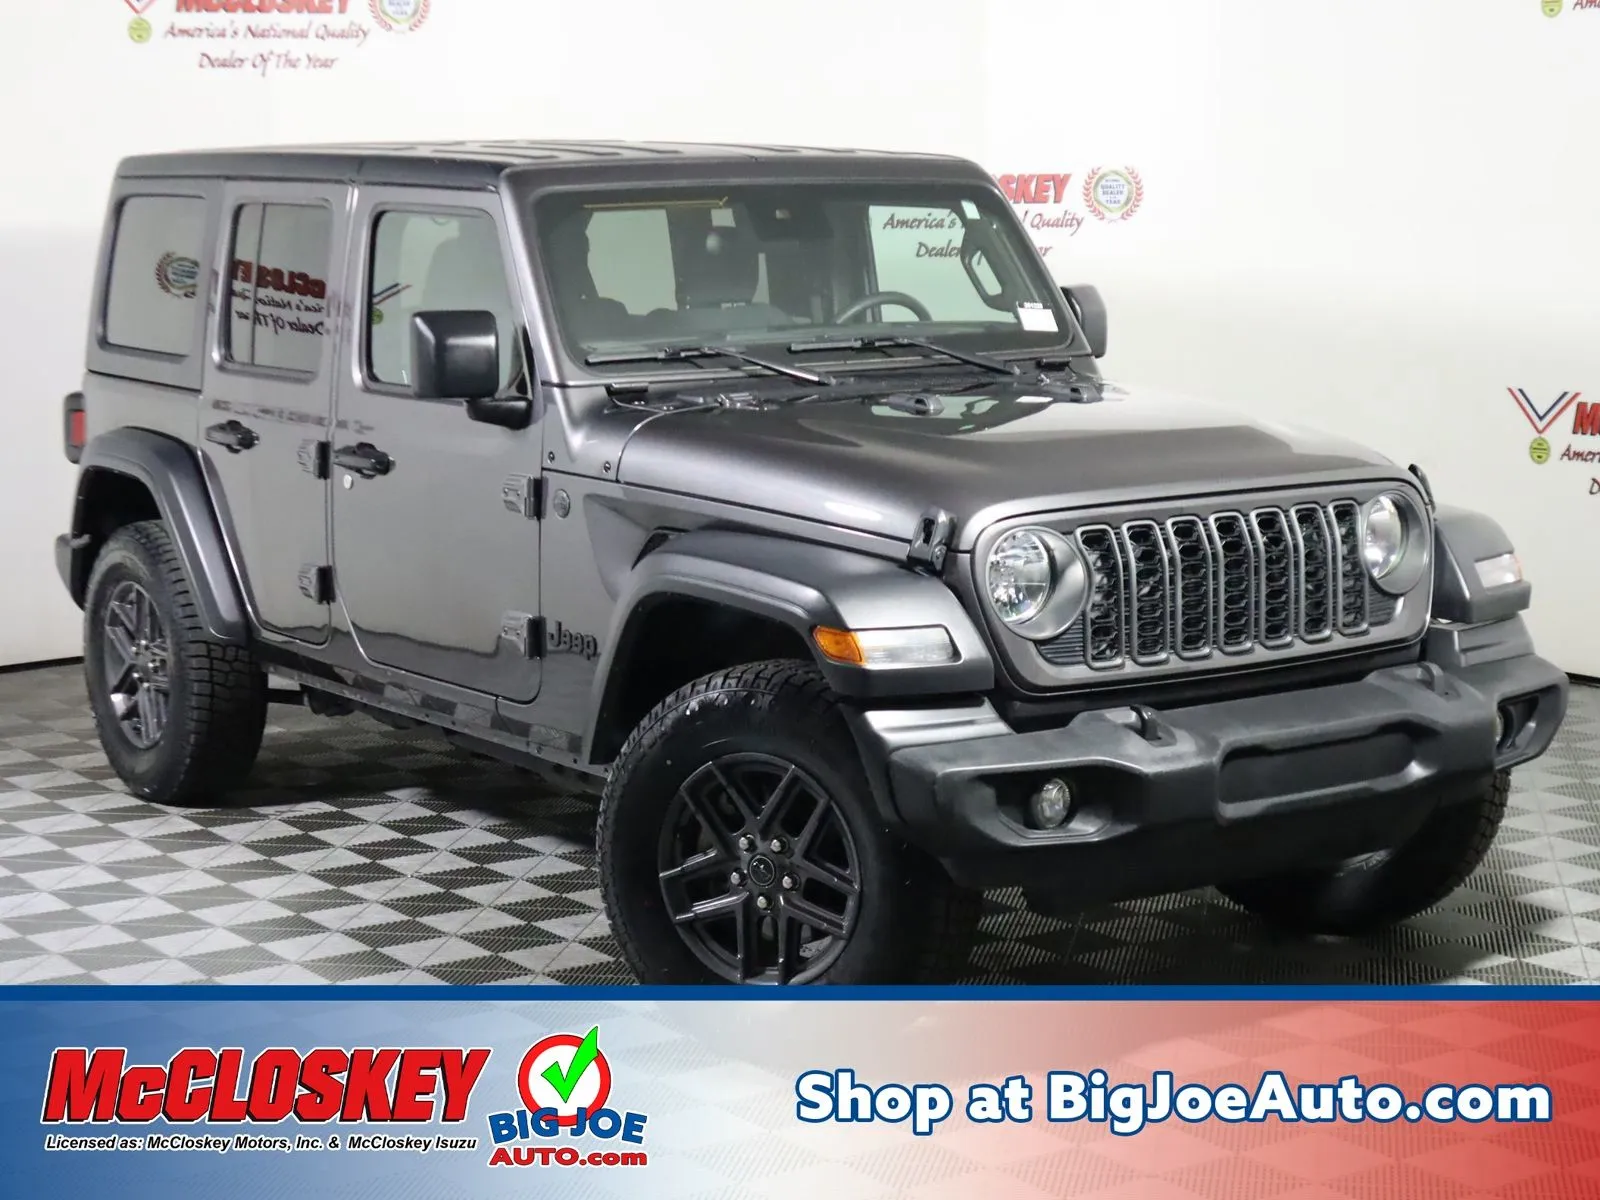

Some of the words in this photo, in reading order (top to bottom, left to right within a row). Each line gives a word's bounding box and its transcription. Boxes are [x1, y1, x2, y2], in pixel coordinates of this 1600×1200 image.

[164, 21, 239, 39] America's
[244, 20, 311, 39] National
[315, 20, 370, 47] Quality
[199, 51, 247, 69] Dealer
[252, 50, 274, 77] Of
[275, 51, 301, 69] The
[305, 53, 339, 69] Year
[882, 210, 957, 230] America's
[1030, 210, 1084, 237] Quality
[547, 620, 598, 661] Jeep
